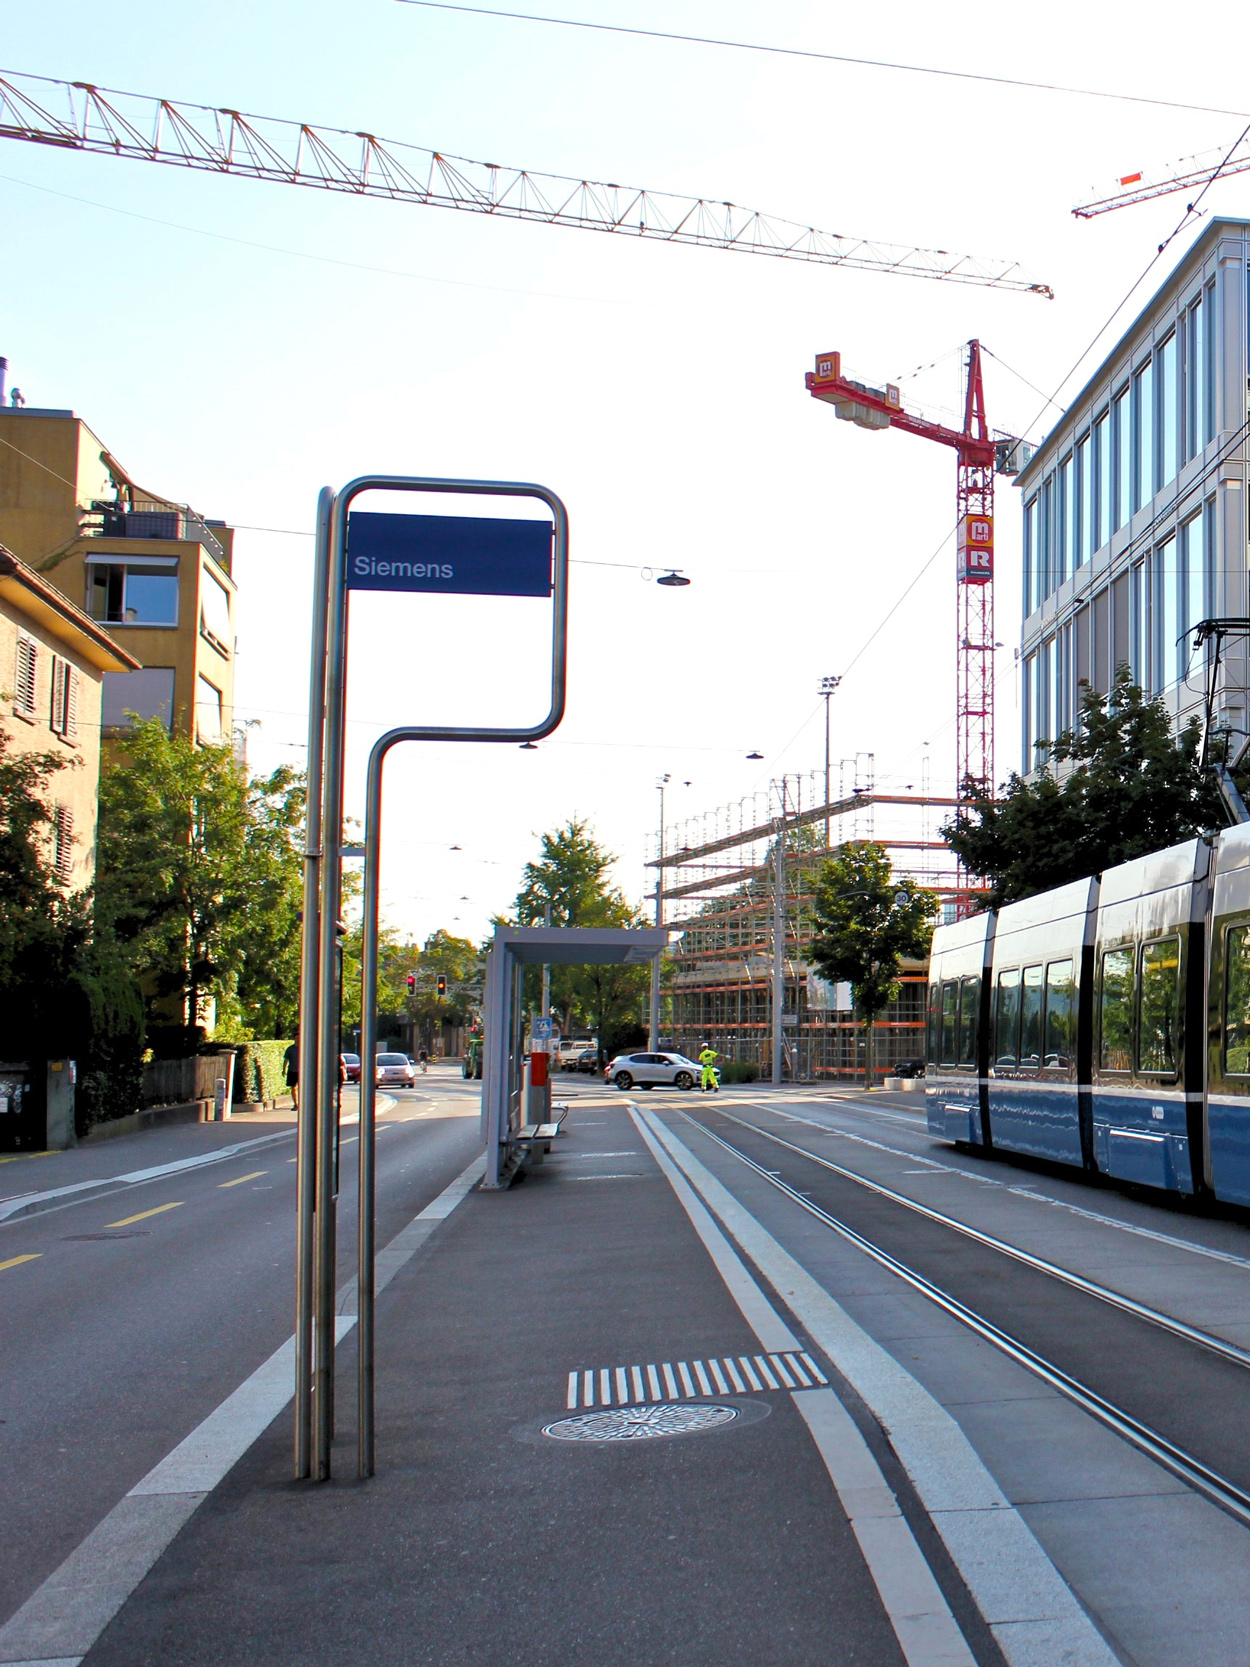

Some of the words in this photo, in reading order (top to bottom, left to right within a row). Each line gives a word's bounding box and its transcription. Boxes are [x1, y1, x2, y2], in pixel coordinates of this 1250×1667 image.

[971, 521, 989, 541] marti
[354, 556, 453, 578] Siemens
[970, 550, 990, 567] R
